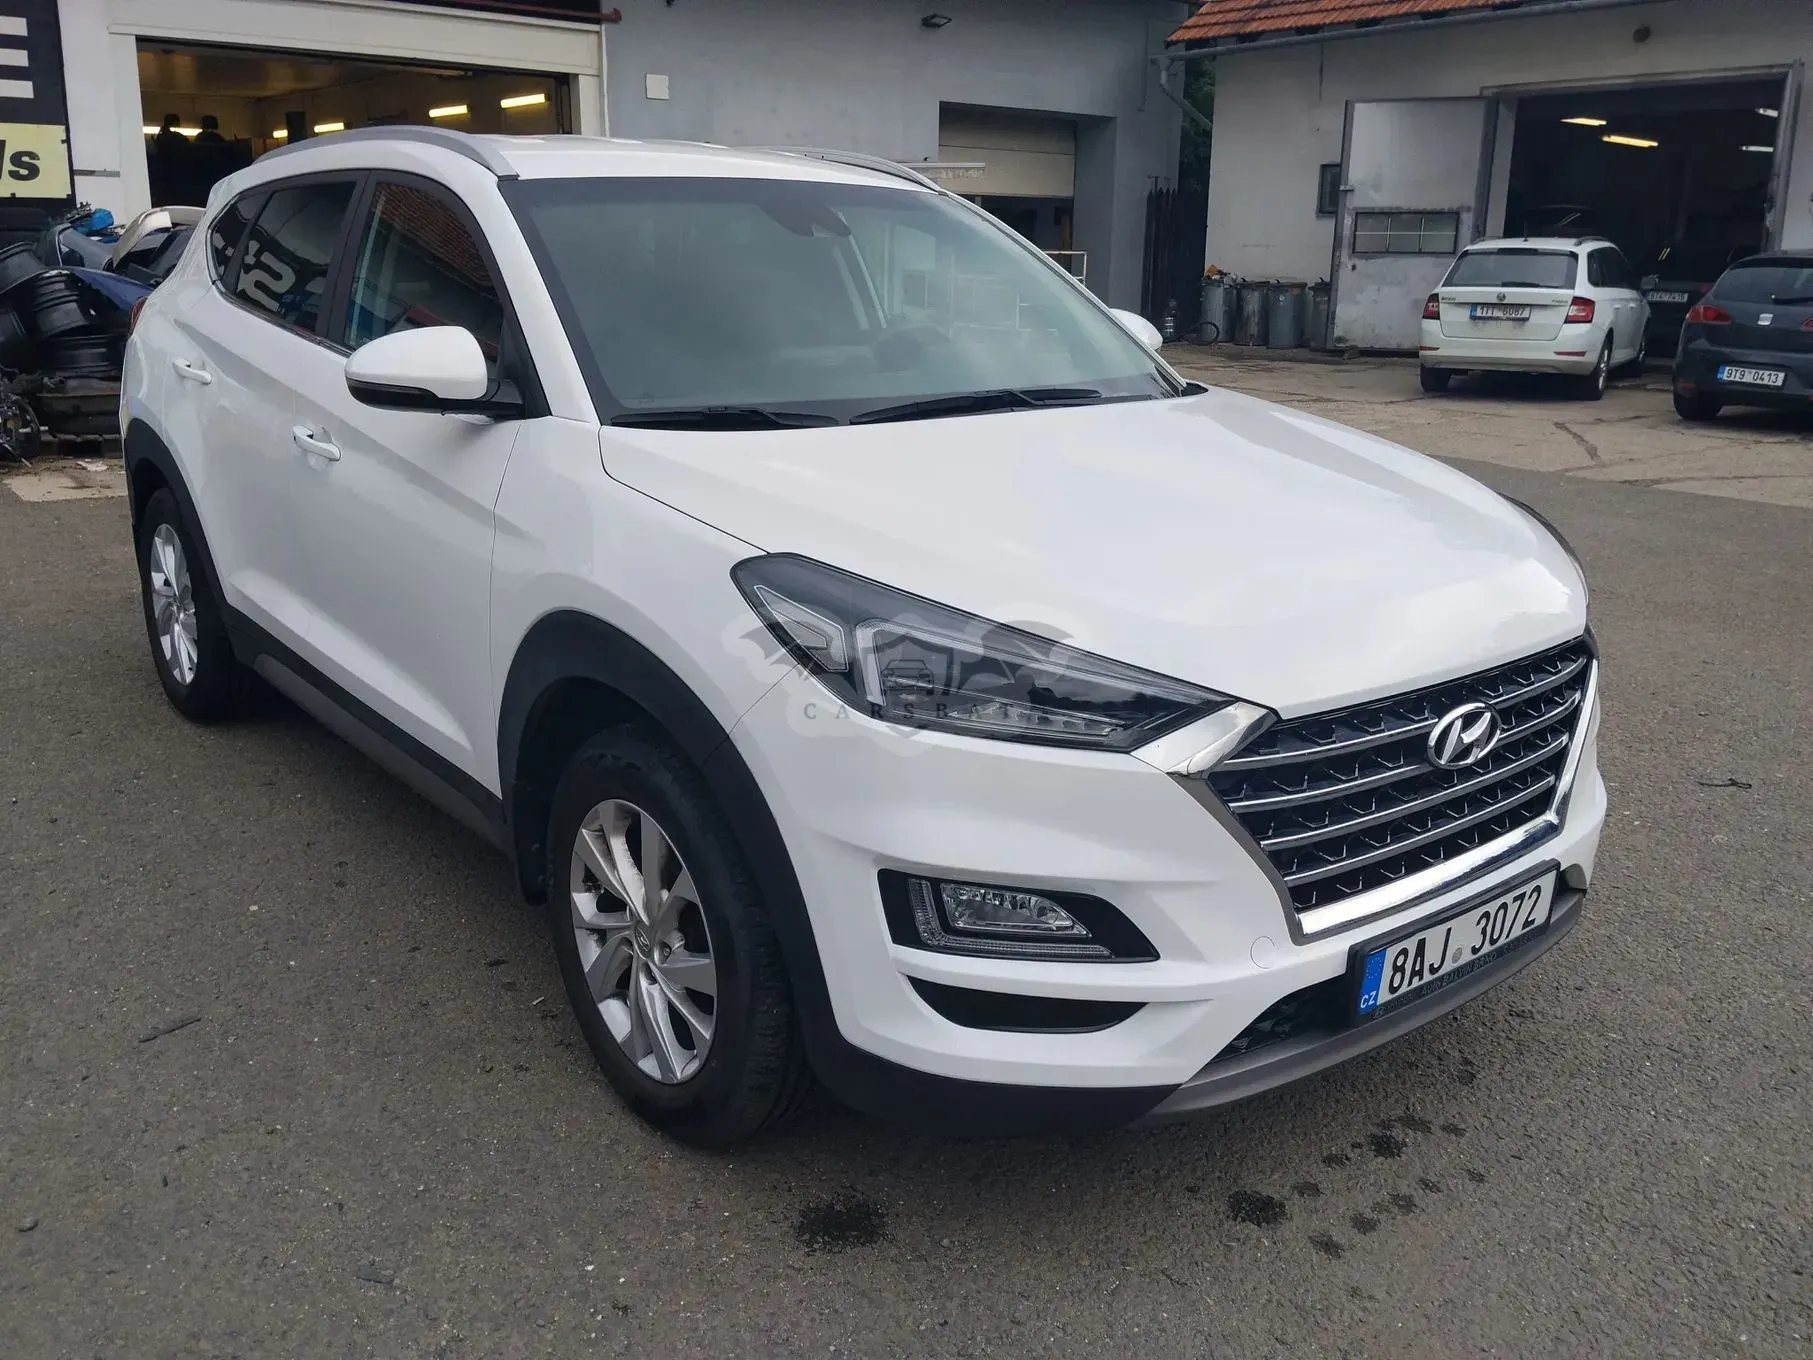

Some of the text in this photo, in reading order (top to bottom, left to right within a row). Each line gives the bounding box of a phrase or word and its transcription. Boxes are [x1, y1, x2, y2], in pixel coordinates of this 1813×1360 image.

[1726, 368, 1780, 384] 9T9 0413
[1388, 884, 1542, 995] 8AJ 3072
[1359, 989, 1378, 1010] CZ
